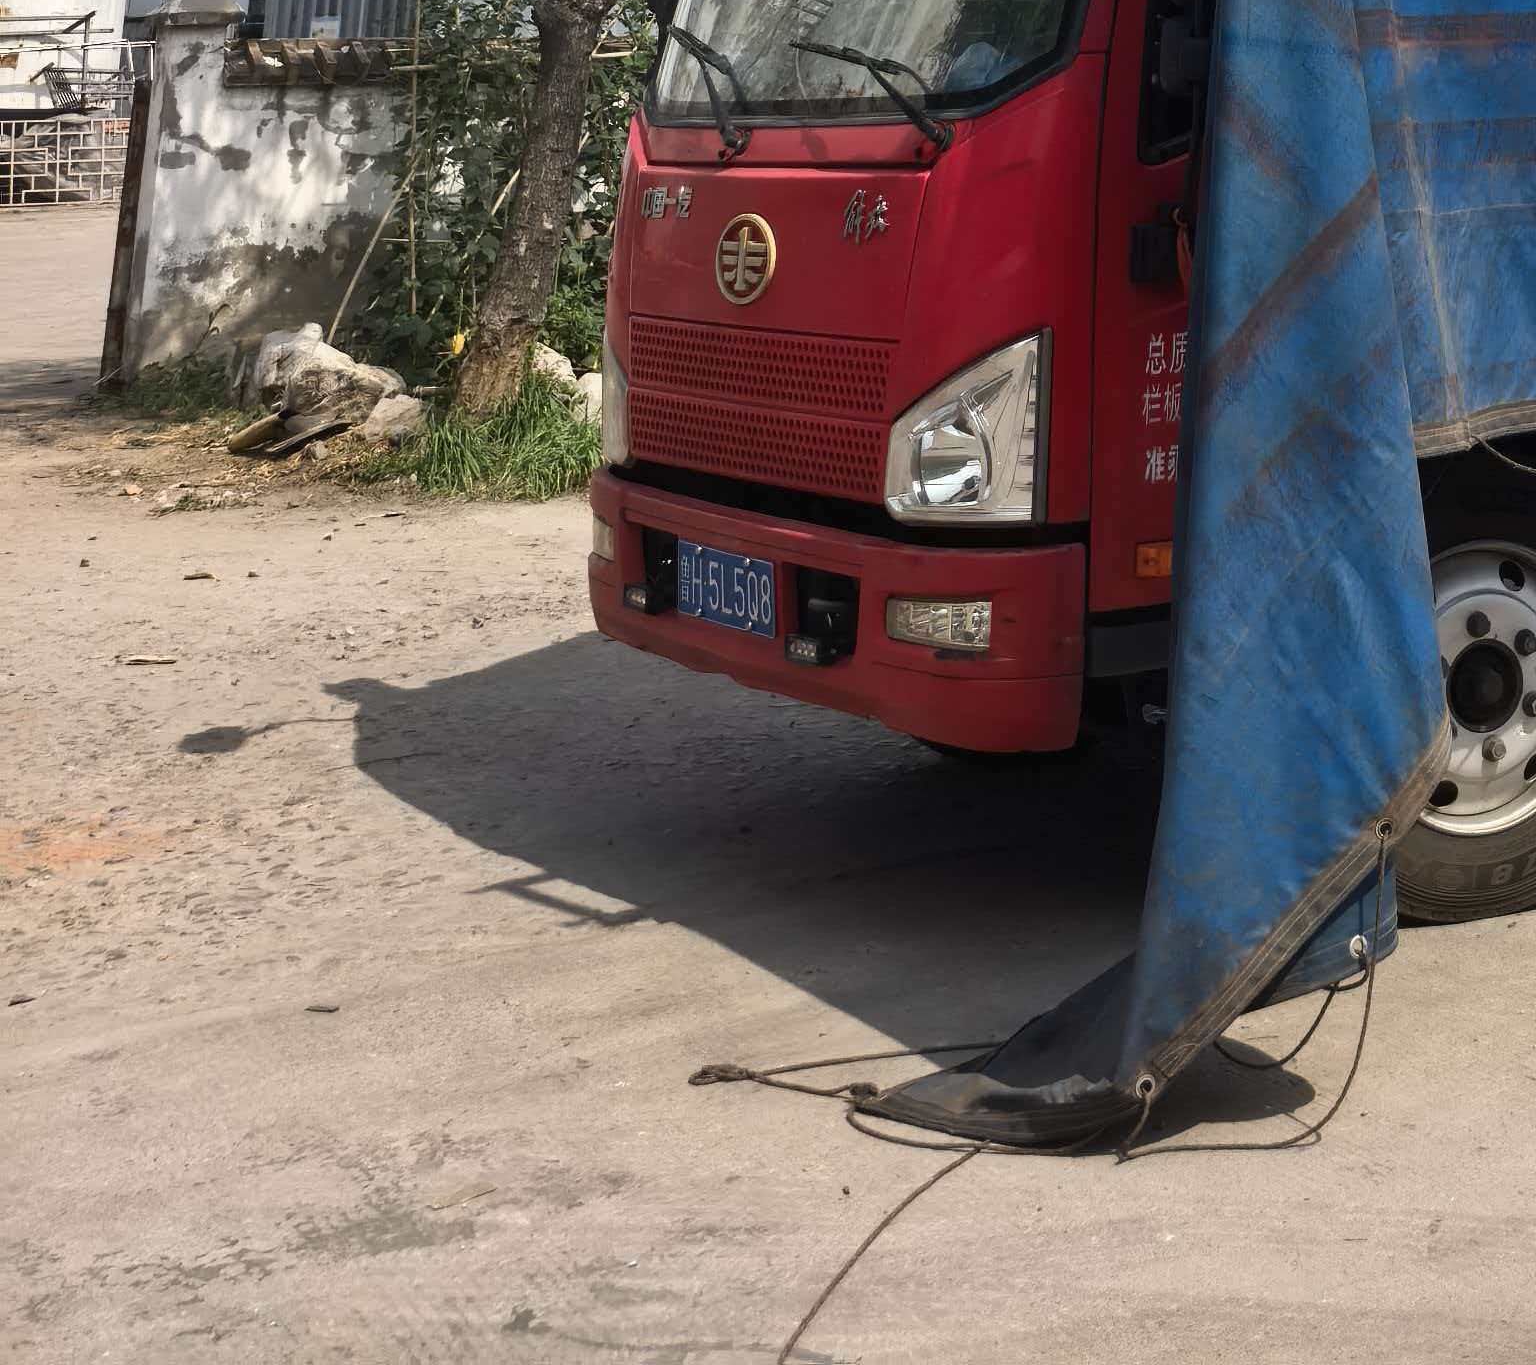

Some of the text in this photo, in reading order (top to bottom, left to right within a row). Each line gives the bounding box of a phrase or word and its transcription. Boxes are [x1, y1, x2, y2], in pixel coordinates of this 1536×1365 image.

[641, 186, 692, 218] 中国一汽
[843, 189, 889, 245] 解放
